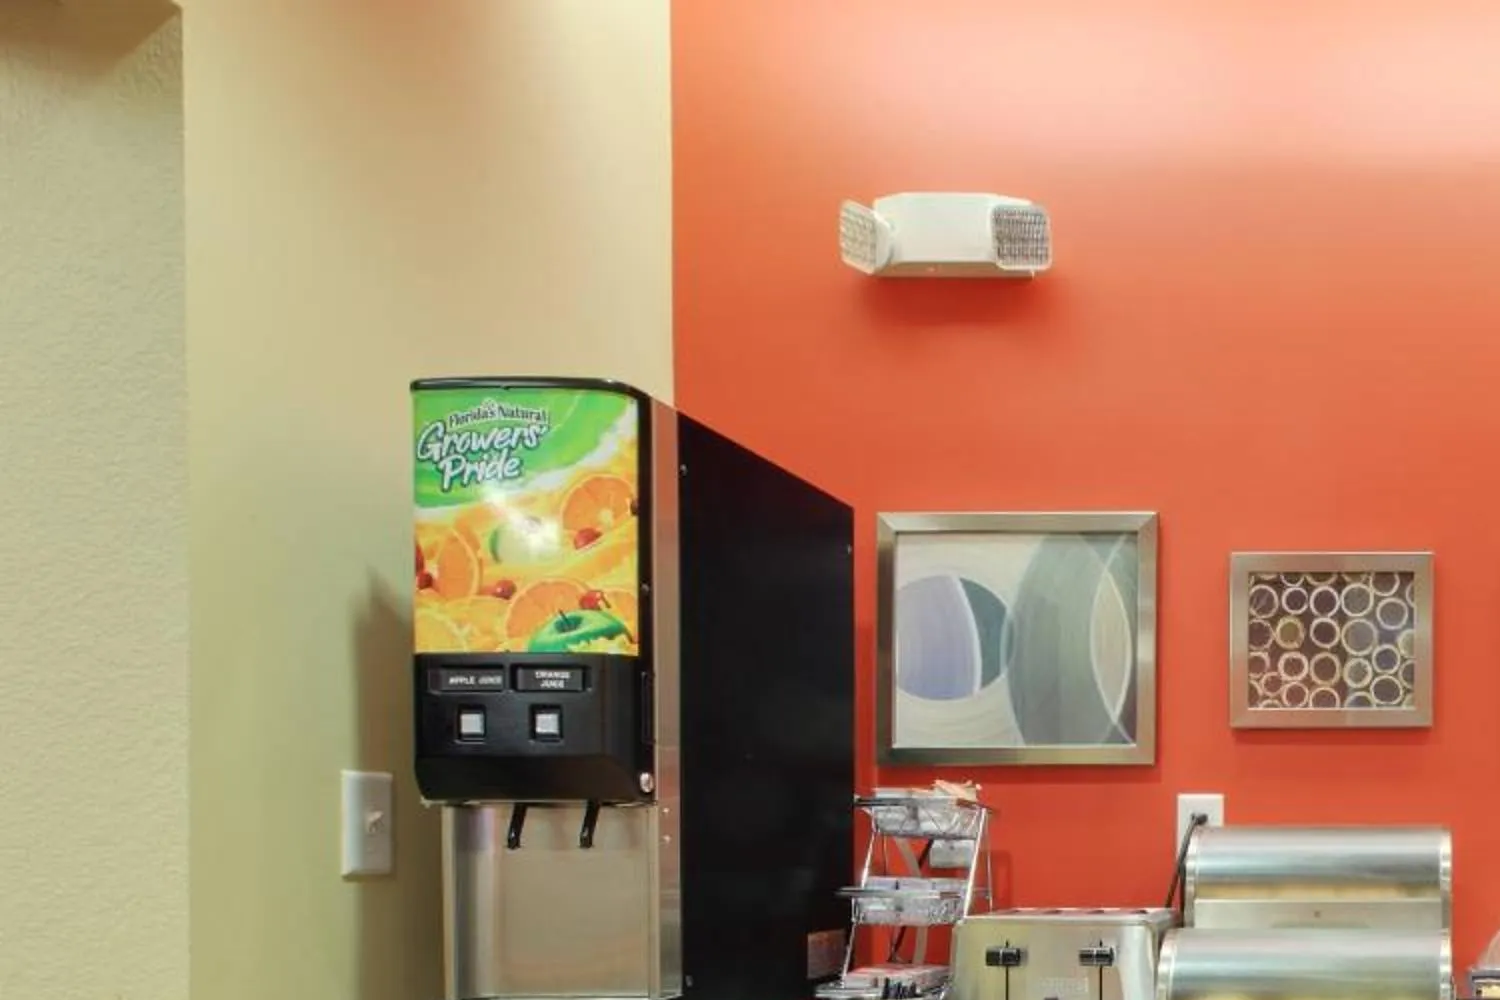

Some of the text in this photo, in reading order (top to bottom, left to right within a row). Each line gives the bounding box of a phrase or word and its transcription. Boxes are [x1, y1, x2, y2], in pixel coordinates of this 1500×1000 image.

[449, 404, 547, 428] Florida's Natural
[438, 450, 523, 492] Pride
[448, 675, 476, 685] APPLE
